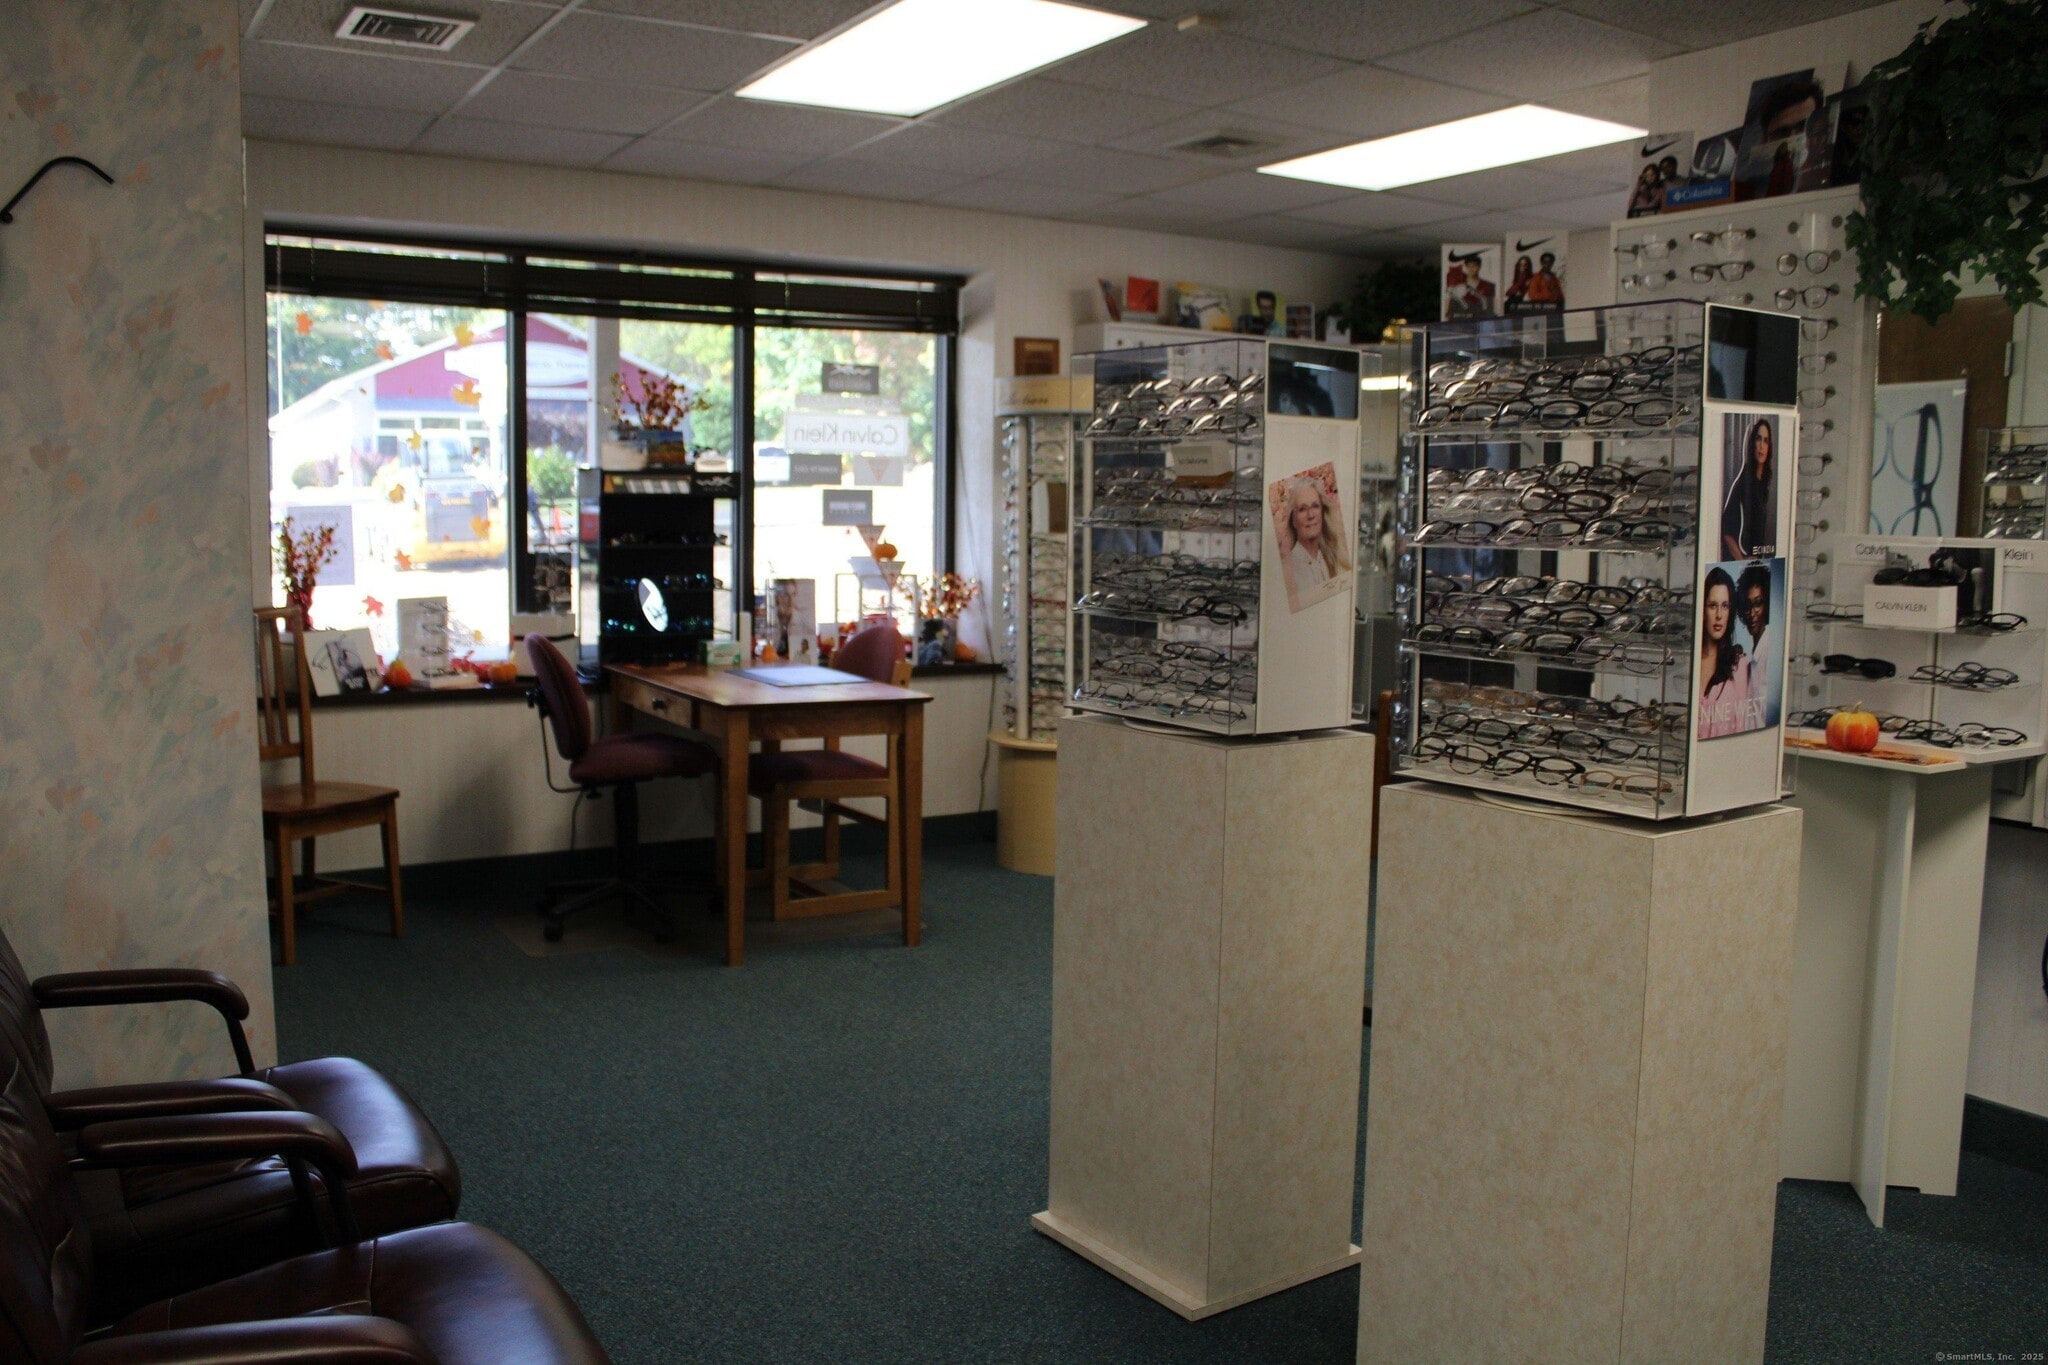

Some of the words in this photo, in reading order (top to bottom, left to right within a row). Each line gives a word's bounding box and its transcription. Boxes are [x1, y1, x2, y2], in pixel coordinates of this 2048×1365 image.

[2004, 548, 2034, 561] Klein
[1875, 601, 1904, 611] CALVIN
[1905, 603, 1928, 612] KLEIN
[1701, 702, 1732, 725] NINE
[1735, 696, 1766, 721] WEST
